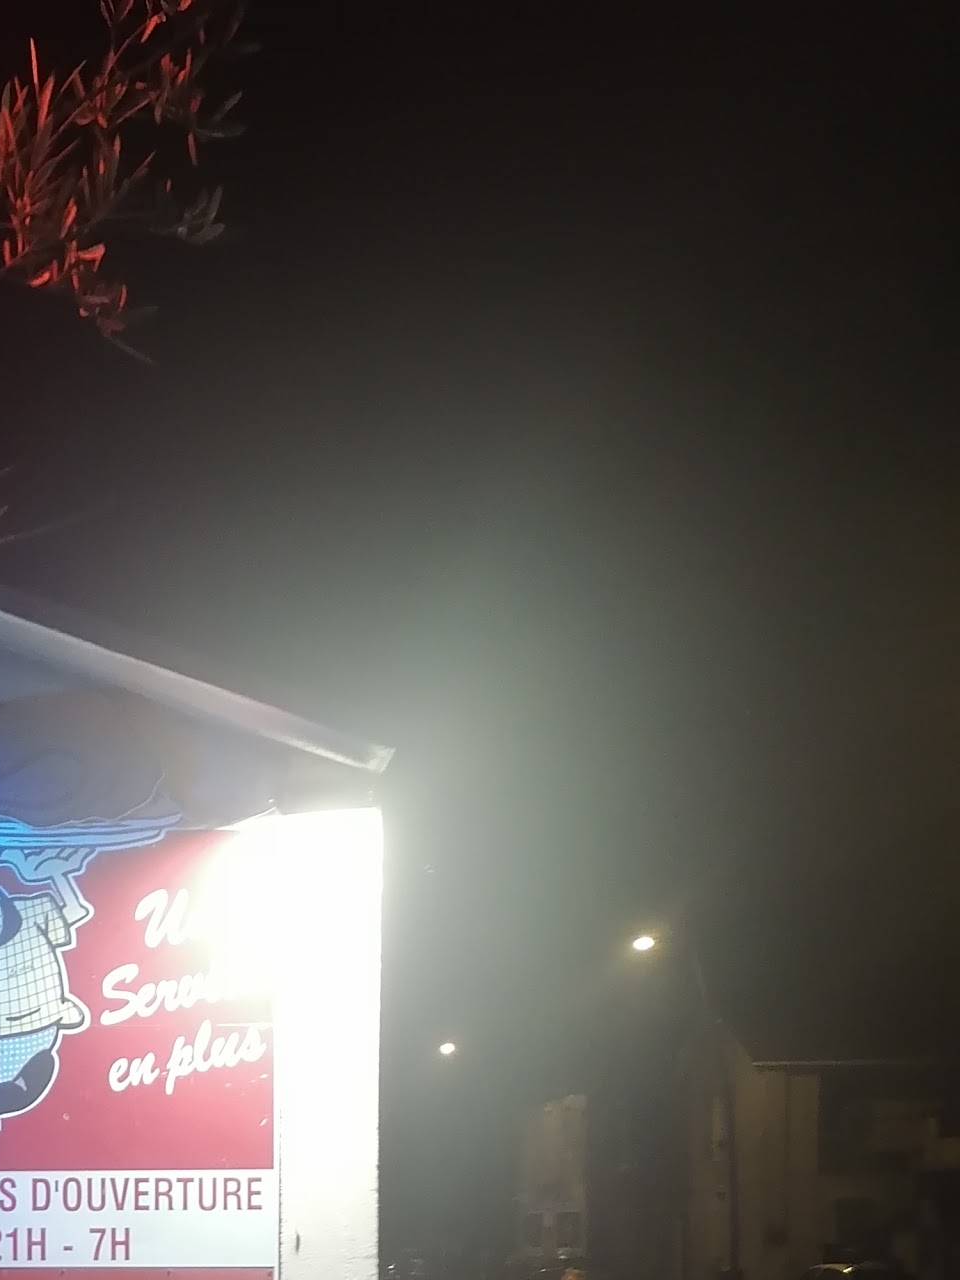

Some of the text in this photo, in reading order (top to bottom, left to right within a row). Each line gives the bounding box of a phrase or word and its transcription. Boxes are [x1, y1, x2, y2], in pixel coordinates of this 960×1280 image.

[108, 1019, 267, 1096] en plus
[32, 1177, 263, 1212] D'OUVERTURE
[89, 1228, 131, 1261] 7H
